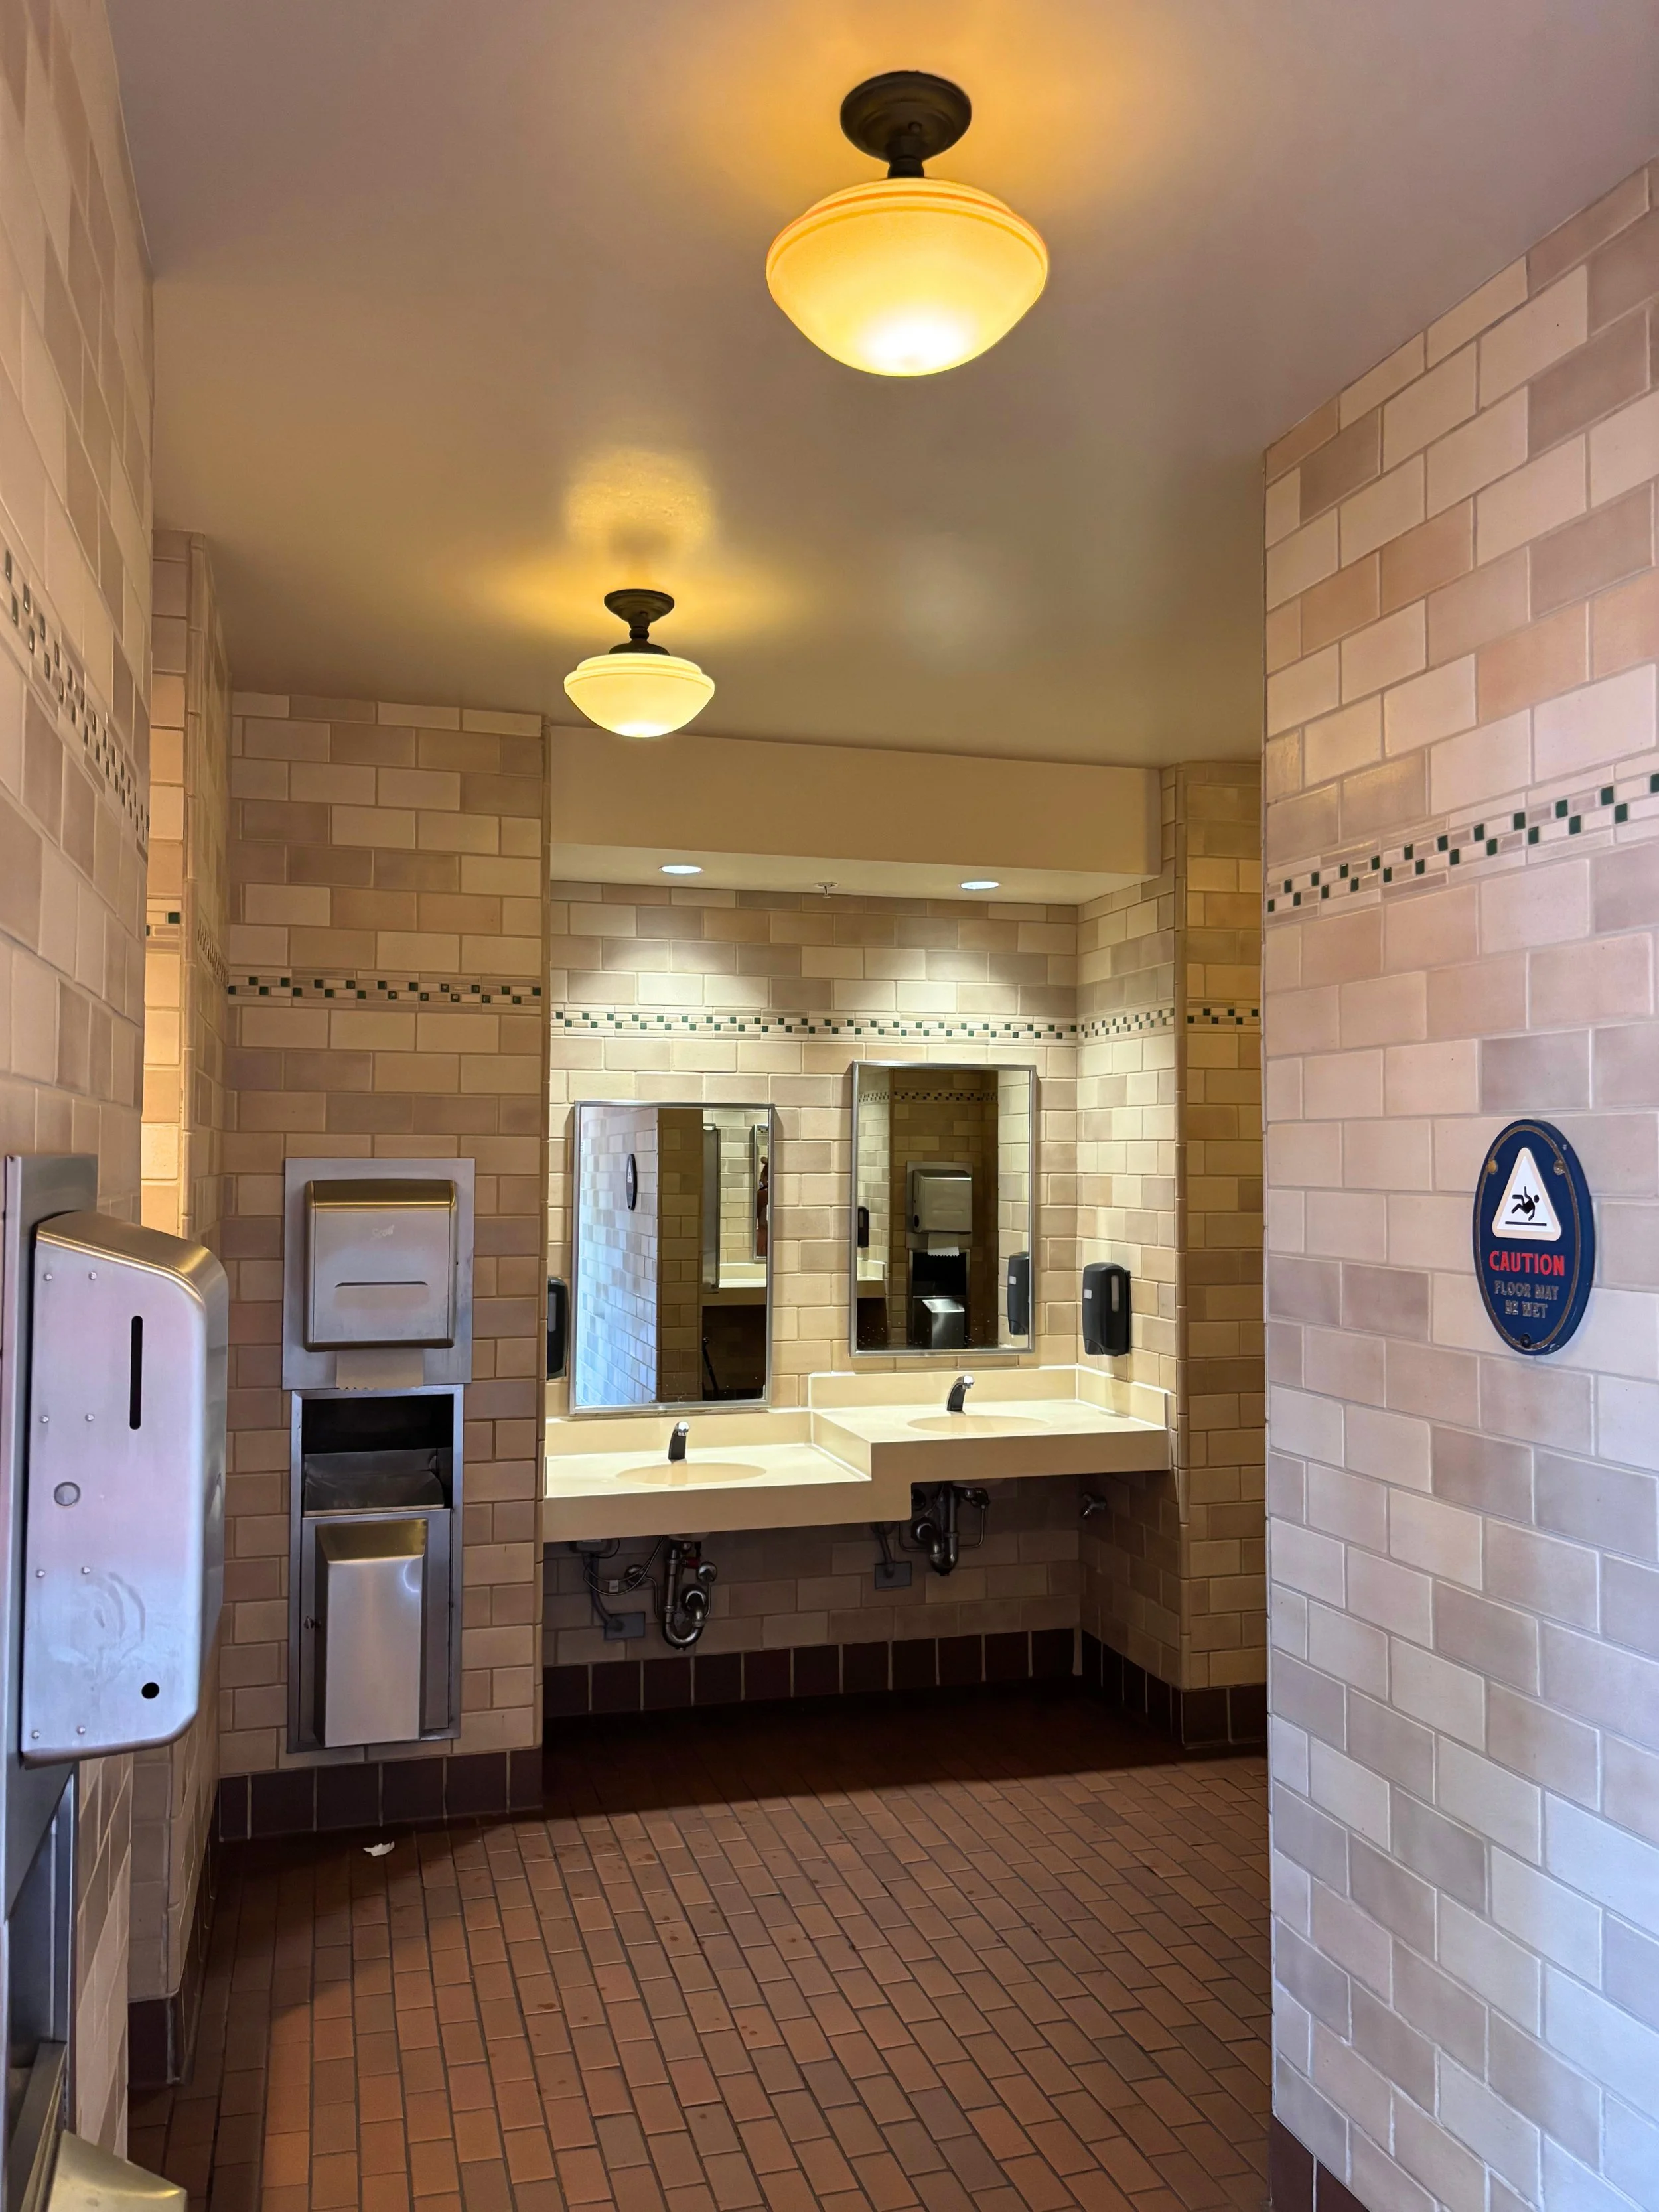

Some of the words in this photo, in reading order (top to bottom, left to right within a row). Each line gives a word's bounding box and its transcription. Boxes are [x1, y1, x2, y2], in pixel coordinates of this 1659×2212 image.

[1489, 1250, 1565, 1276] CAUTION
[1494, 1280, 1531, 1298] FLOOR
[1534, 1284, 1559, 1300] MAY
[1505, 1300, 1518, 1315] BE
[1522, 1301, 1548, 1318] WET
